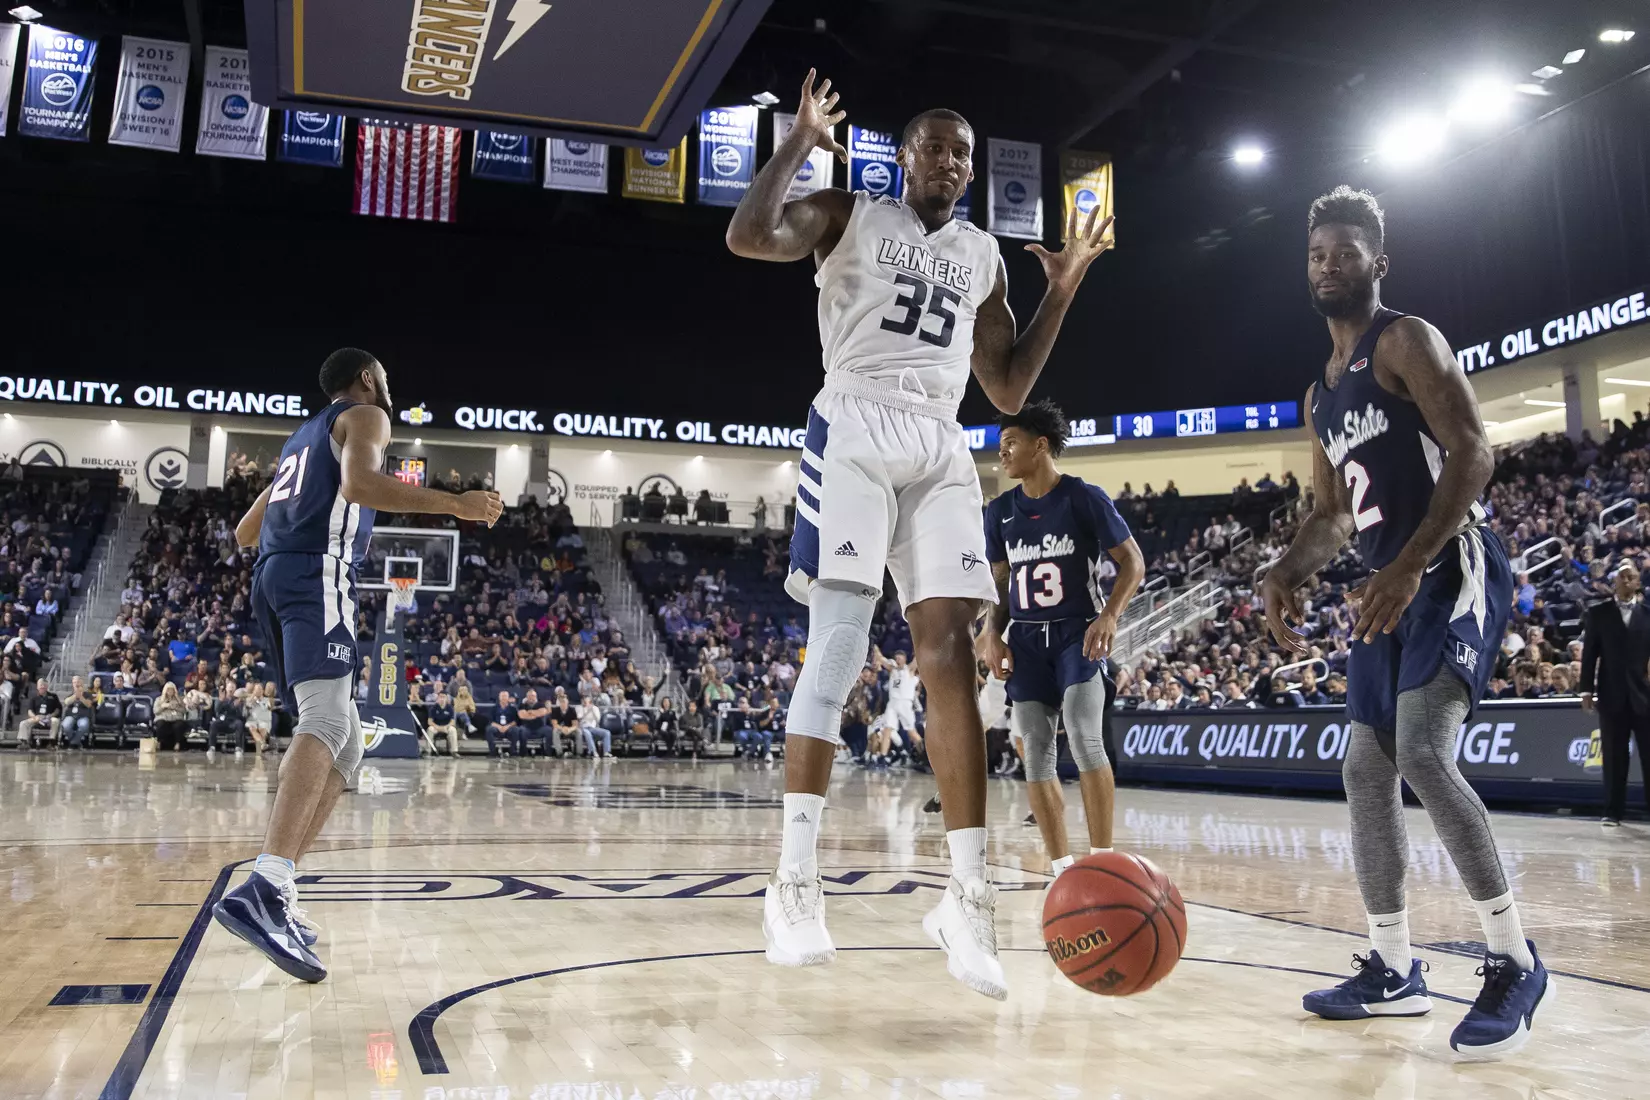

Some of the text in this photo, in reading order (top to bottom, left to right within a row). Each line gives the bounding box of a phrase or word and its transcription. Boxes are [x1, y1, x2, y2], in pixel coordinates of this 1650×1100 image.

[136, 47, 174, 62] 2015
[401, 0, 496, 100] ANCERS
[137, 62, 168, 72] MEN'S
[219, 57, 248, 70] 201
[122, 70, 183, 84] BASKETBALL
[206, 80, 250, 90] BASKETB
[120, 112, 166, 125] DIVISION
[708, 111, 742, 126] 201
[122, 123, 170, 136] SWEET 16
[210, 123, 249, 134] DIVISION
[860, 129, 893, 143] 2017
[854, 141, 896, 154] WOMEN'S
[999, 148, 1029, 161] 2017
[850, 150, 897, 163] BASKETBA
[551, 166, 601, 177] CHAMPIONS
[627, 183, 665, 195] RUNNER
[878, 238, 972, 293] LANCERS
[880, 272, 962, 348] 35
[1501, 328, 1539, 360] OIL
[1542, 292, 1650, 346] CHANGE.
[0, 376, 309, 417] QUALITY. OIL CHANGE.
[454, 406, 806, 448] QUICK. QUALITY. OIL CHANG
[1069, 418, 1097, 437] 1:03
[1132, 415, 1154, 437] 30
[1343, 402, 1389, 450] State
[81, 457, 138, 467] BIBLICALLY
[268, 445, 310, 504] 21
[574, 484, 619, 493] EQUIPPED
[574, 492, 617, 500] TO SERVE
[1344, 459, 1384, 533] 2
[1042, 533, 1075, 559] State
[834, 550, 859, 558] adidas
[1016, 562, 1064, 610] 13
[379, 642, 398, 706] CBU
[1123, 724, 1190, 758] QUICK.
[1198, 724, 1308, 761] QUALITY.
[1317, 723, 1352, 760] OI
